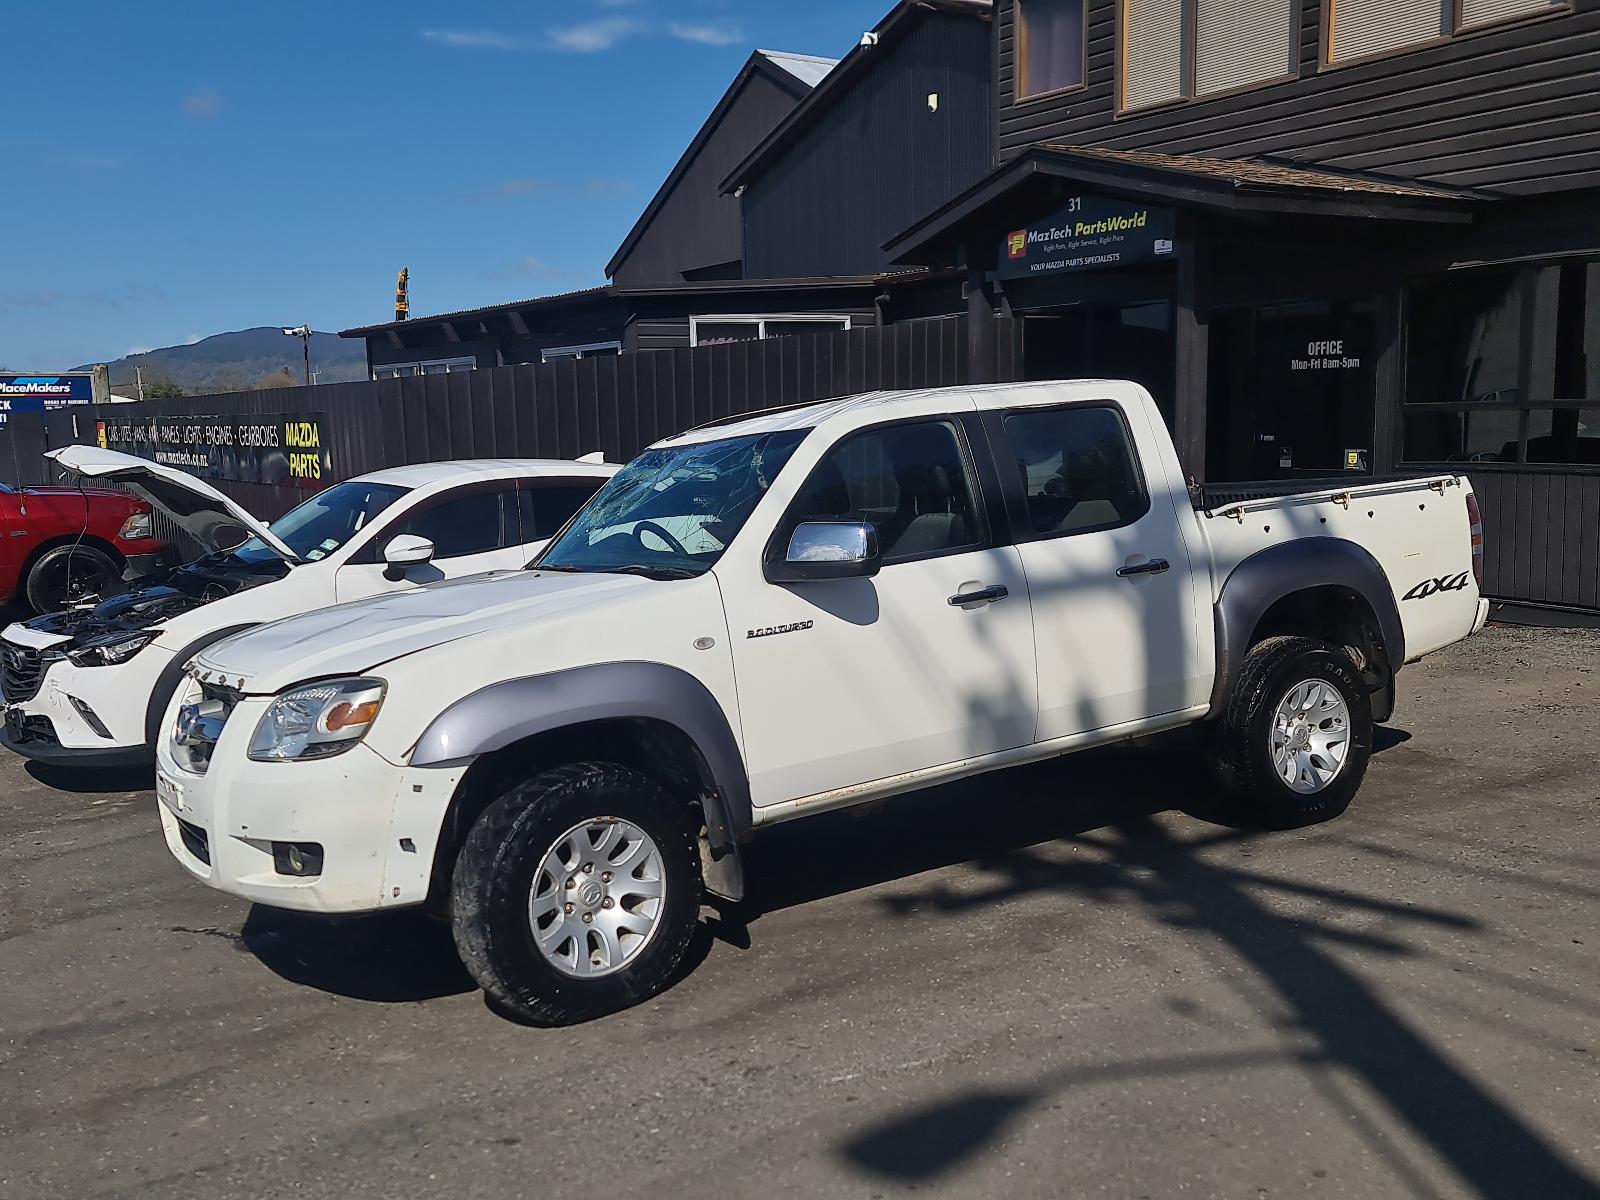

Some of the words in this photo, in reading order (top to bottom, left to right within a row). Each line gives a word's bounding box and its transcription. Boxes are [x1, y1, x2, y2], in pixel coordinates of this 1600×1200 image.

[1067, 196, 1081, 212] 31
[1027, 224, 1072, 244] MazTech
[1075, 210, 1147, 237] PartsWorld
[1030, 262, 1046, 271] YOUR
[1046, 260, 1065, 270] MAZDA
[1066, 257, 1084, 267] PARTS
[1084, 252, 1121, 265] SPECIALISTS
[1307, 340, 1344, 356] OFFICE
[1291, 358, 1321, 370] Mon-Fri
[1322, 357, 1360, 369] 8am-5pm
[161, 425, 180, 444] PANELS
[182, 425, 202, 445] LIGHTS
[205, 425, 233, 446] ENGINES
[239, 425, 279, 447] GEARBOXES
[285, 422, 320, 448] MAZDA
[289, 453, 321, 480] PARTS
